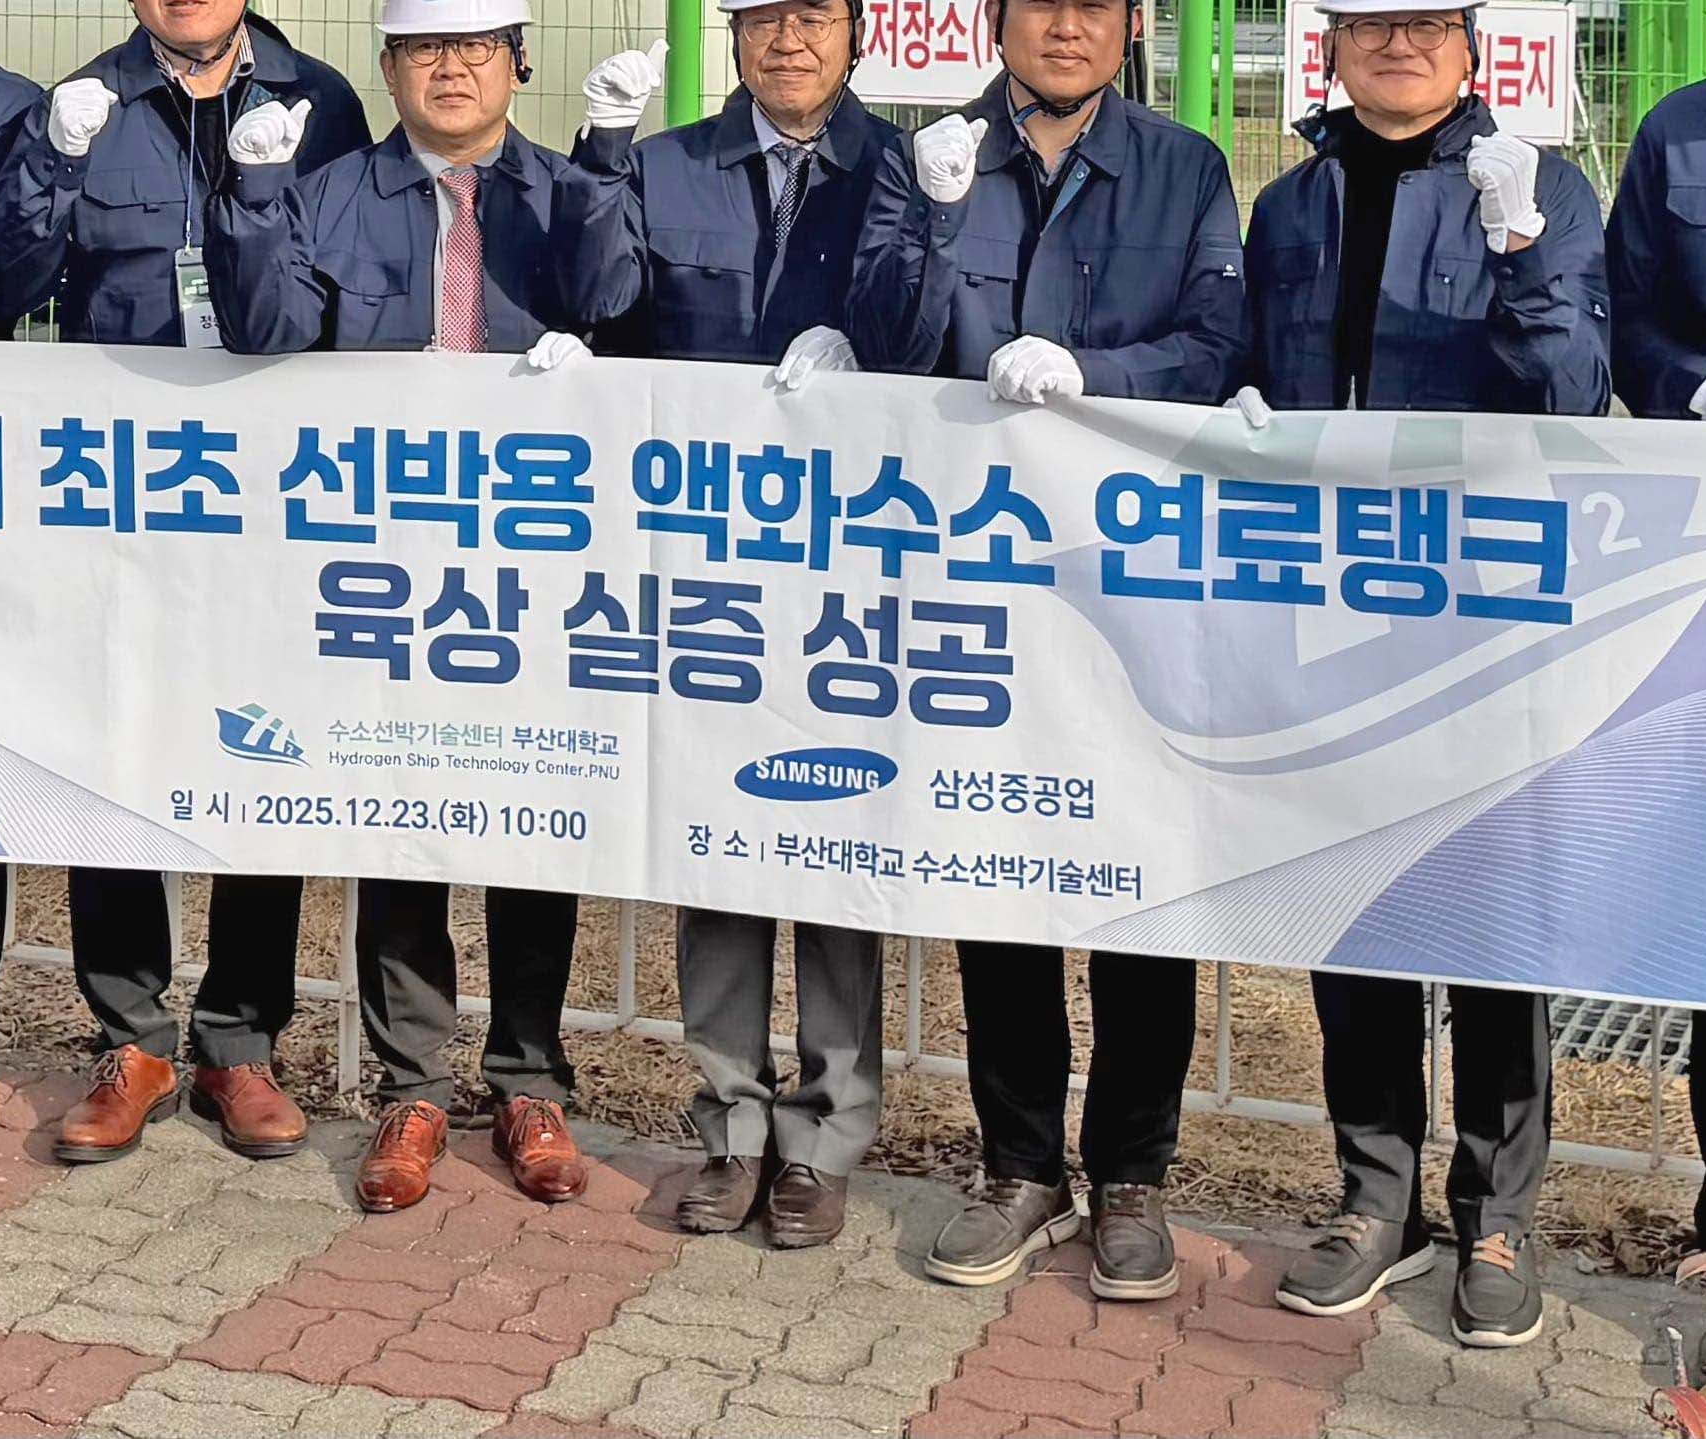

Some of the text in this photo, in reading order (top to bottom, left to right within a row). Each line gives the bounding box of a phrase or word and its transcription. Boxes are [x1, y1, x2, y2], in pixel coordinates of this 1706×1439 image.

[40, 418, 243, 534] 최초
[279, 427, 594, 552] 선박용
[632, 439, 1055, 588] 액화수소
[1095, 469, 1572, 625] 연료탱크
[315, 561, 1013, 728] 육상 실증 성공
[328, 720, 619, 755] 수소선박기술센터 부산대학교
[329, 751, 401, 767] Hydrogen
[407, 753, 440, 769] Ship
[446, 755, 529, 774] Technology
[755, 758, 880, 792] SAMSUNG
[256, 795, 488, 837] 2025.12.23.(화)
[500, 806, 586, 840] 10:00
[930, 770, 1094, 819] 삼성중공업
[774, 833, 905, 878] 부산대학교
[912, 850, 1141, 900] 수소선박기술센터
